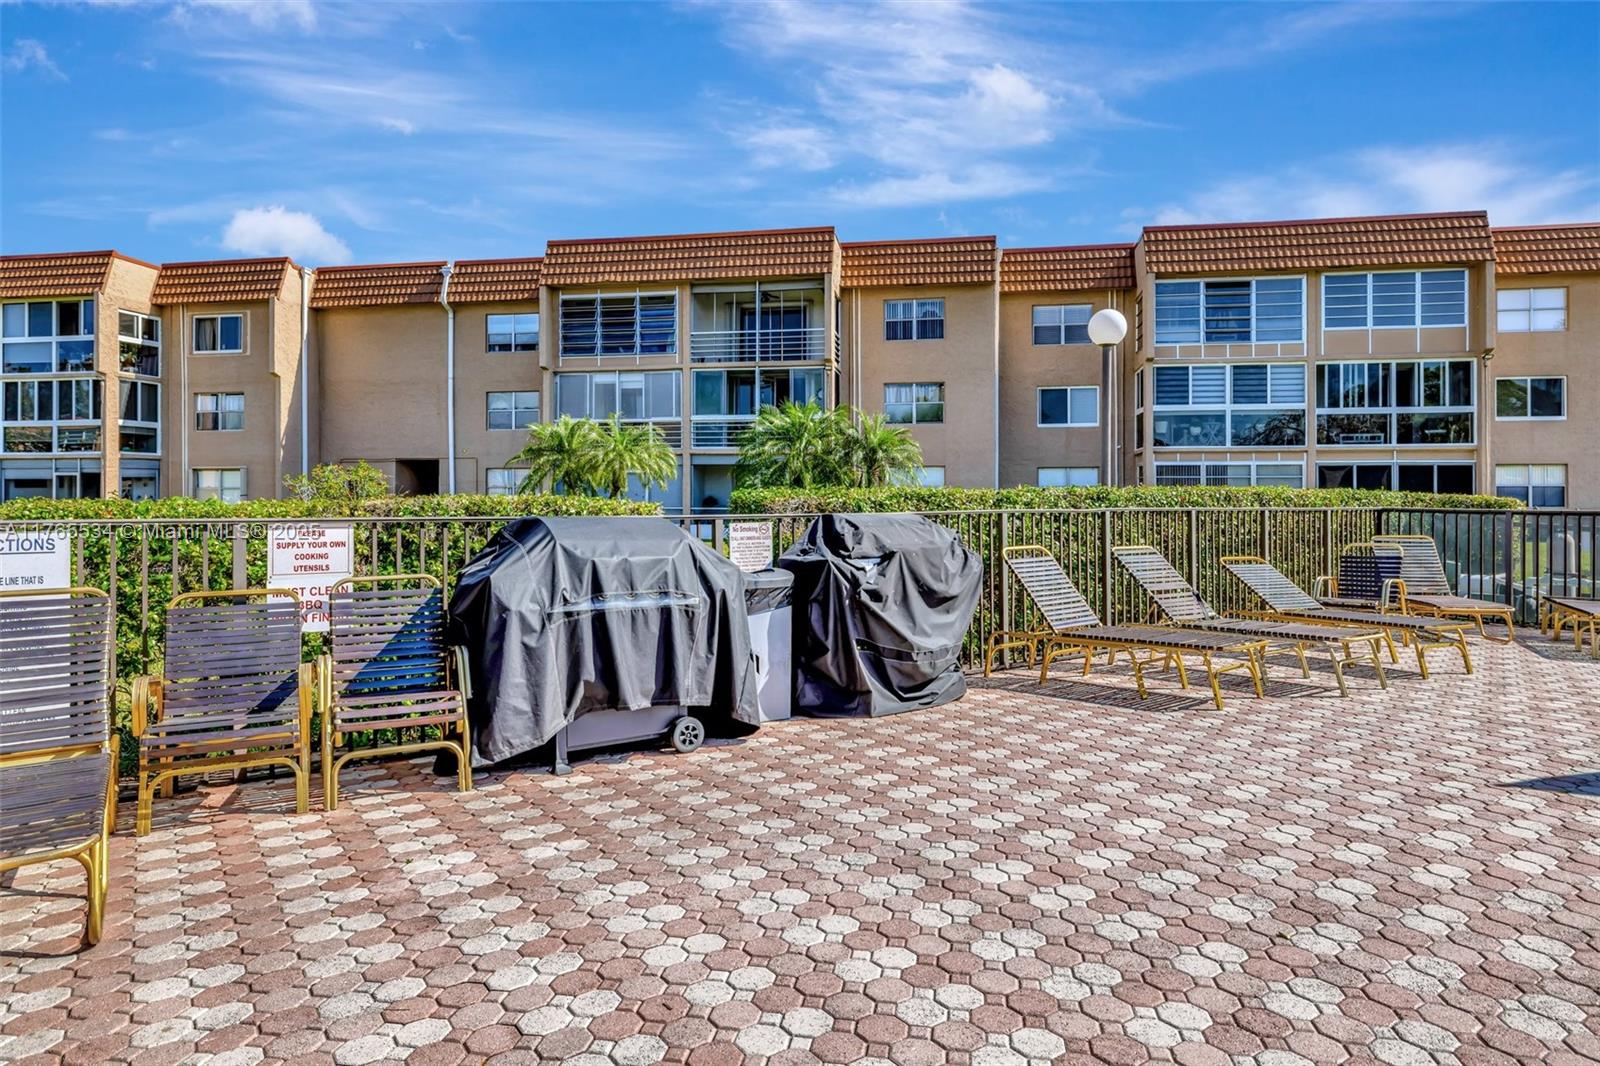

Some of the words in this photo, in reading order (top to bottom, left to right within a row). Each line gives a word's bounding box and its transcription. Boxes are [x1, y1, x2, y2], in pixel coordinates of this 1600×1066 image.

[293, 564, 330, 572] UTENSILS
[5, 577, 19, 586] LINE
[20, 576, 35, 585] THAT
[37, 575, 44, 584] IS
